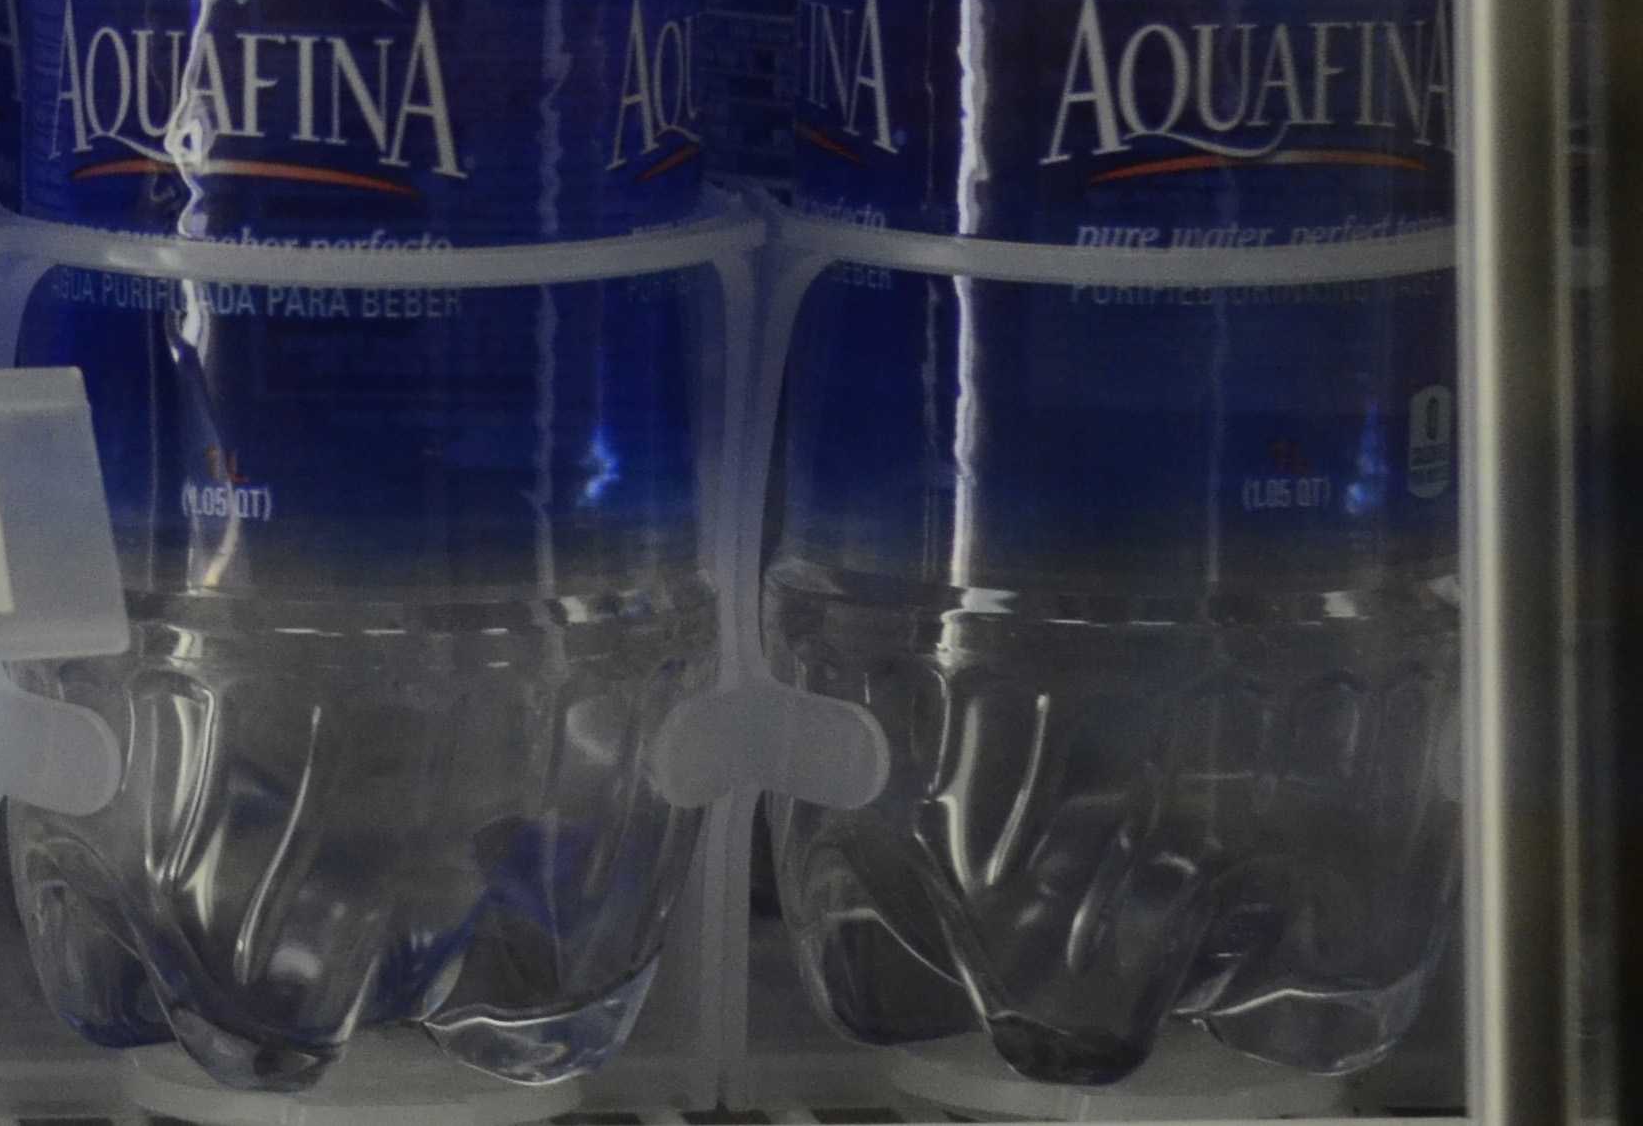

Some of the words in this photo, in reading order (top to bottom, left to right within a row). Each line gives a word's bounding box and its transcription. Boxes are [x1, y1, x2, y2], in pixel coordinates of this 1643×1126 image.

[101, 274, 257, 316] PURIFIADA
[266, 284, 351, 317] PARA
[362, 286, 462, 318] BEBER
